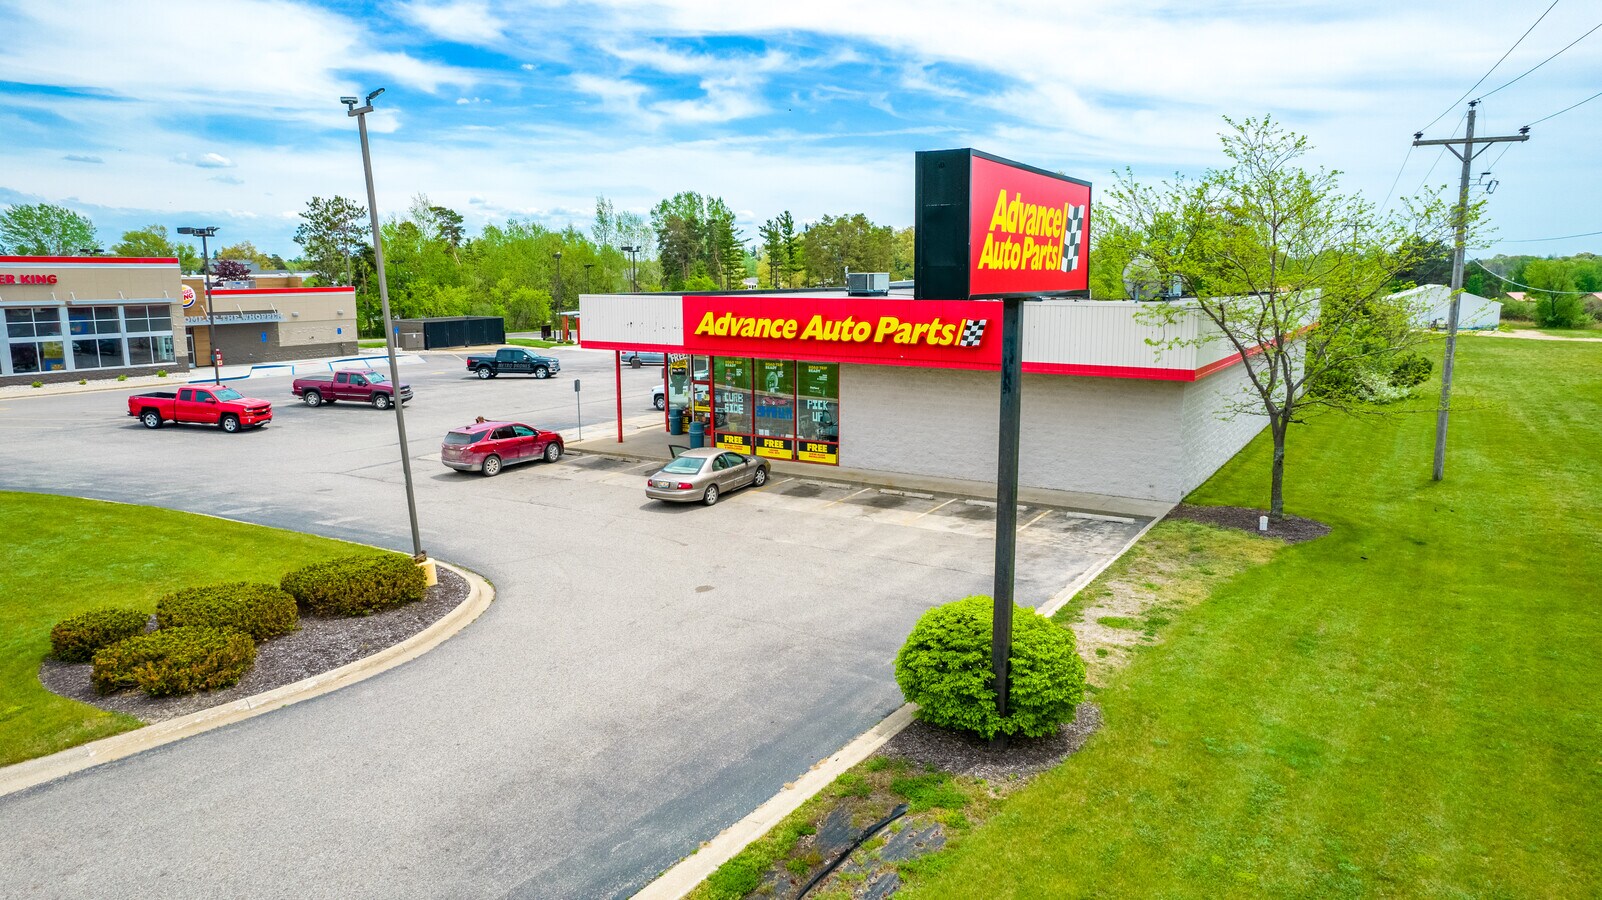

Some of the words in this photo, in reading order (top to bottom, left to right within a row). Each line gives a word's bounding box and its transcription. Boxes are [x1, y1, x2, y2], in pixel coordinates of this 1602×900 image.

[989, 189, 1062, 238] Advance
[977, 233, 1021, 270] Auto
[1021, 236, 1059, 271] Parts
[20, 274, 57, 284] KING
[220, 314, 240, 322] THE
[241, 312, 283, 321] WHOPPER
[694, 312, 798, 339] Advance
[799, 315, 872, 343] Auto
[873, 317, 956, 346] Parts
[724, 393, 744, 403] CURB
[724, 404, 744, 414] SIDE
[807, 400, 829, 410] PICK
[812, 411, 823, 422] UP
[724, 435, 743, 444] FREE
[764, 439, 784, 448] FREE
[807, 443, 828, 453] FREE
